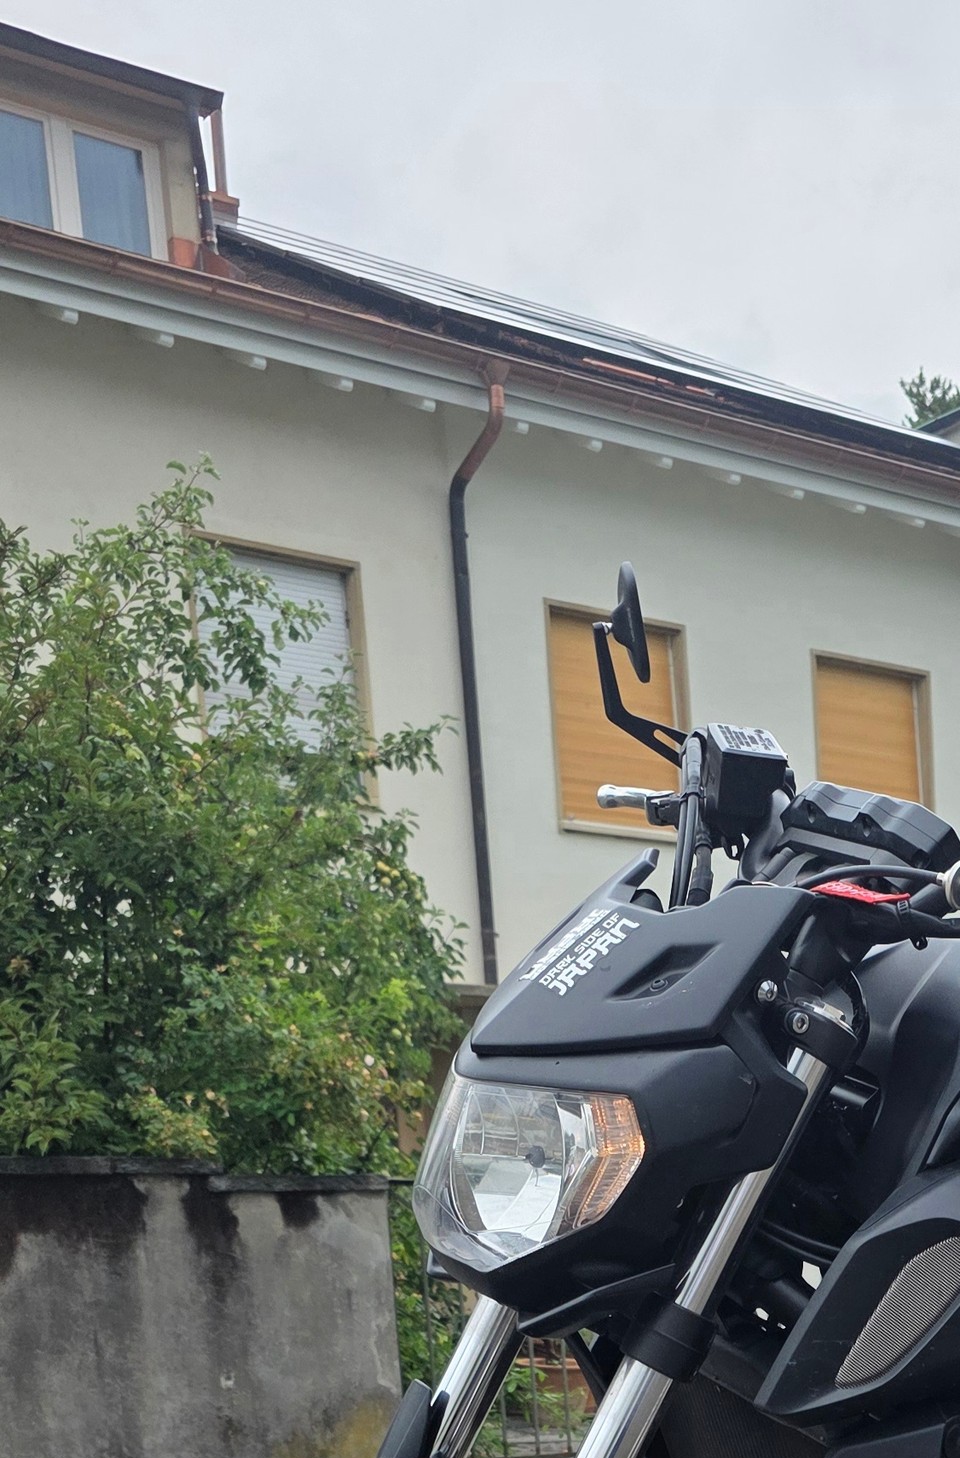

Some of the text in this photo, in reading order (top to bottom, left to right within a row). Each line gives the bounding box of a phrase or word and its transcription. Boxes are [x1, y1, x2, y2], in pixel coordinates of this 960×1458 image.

[539, 912, 620, 985] DARK SIDE OF
[548, 918, 640, 996] JAPAN
